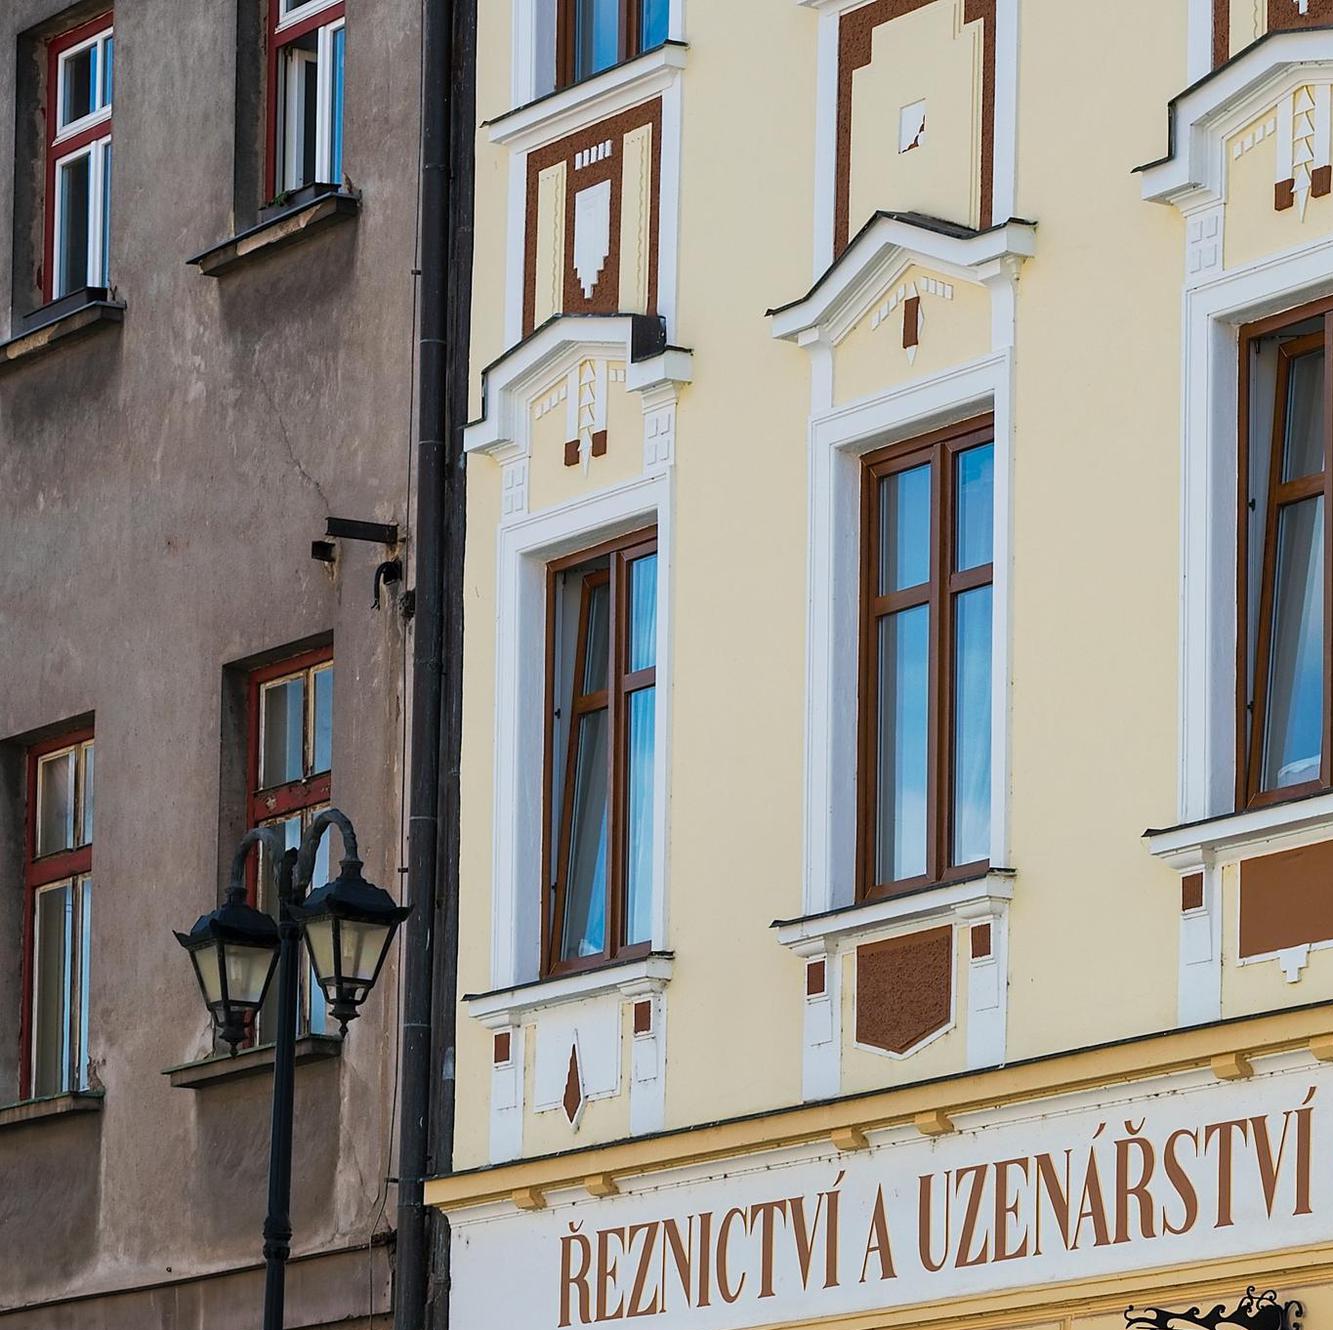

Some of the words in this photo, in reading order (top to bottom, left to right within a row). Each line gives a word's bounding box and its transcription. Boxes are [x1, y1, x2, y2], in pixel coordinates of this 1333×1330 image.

[558, 1170, 845, 1328] ŘEZNICTVÍ
[858, 1183, 898, 1283] A
[918, 1085, 1316, 1272] UZENÁŘSTVÍ
